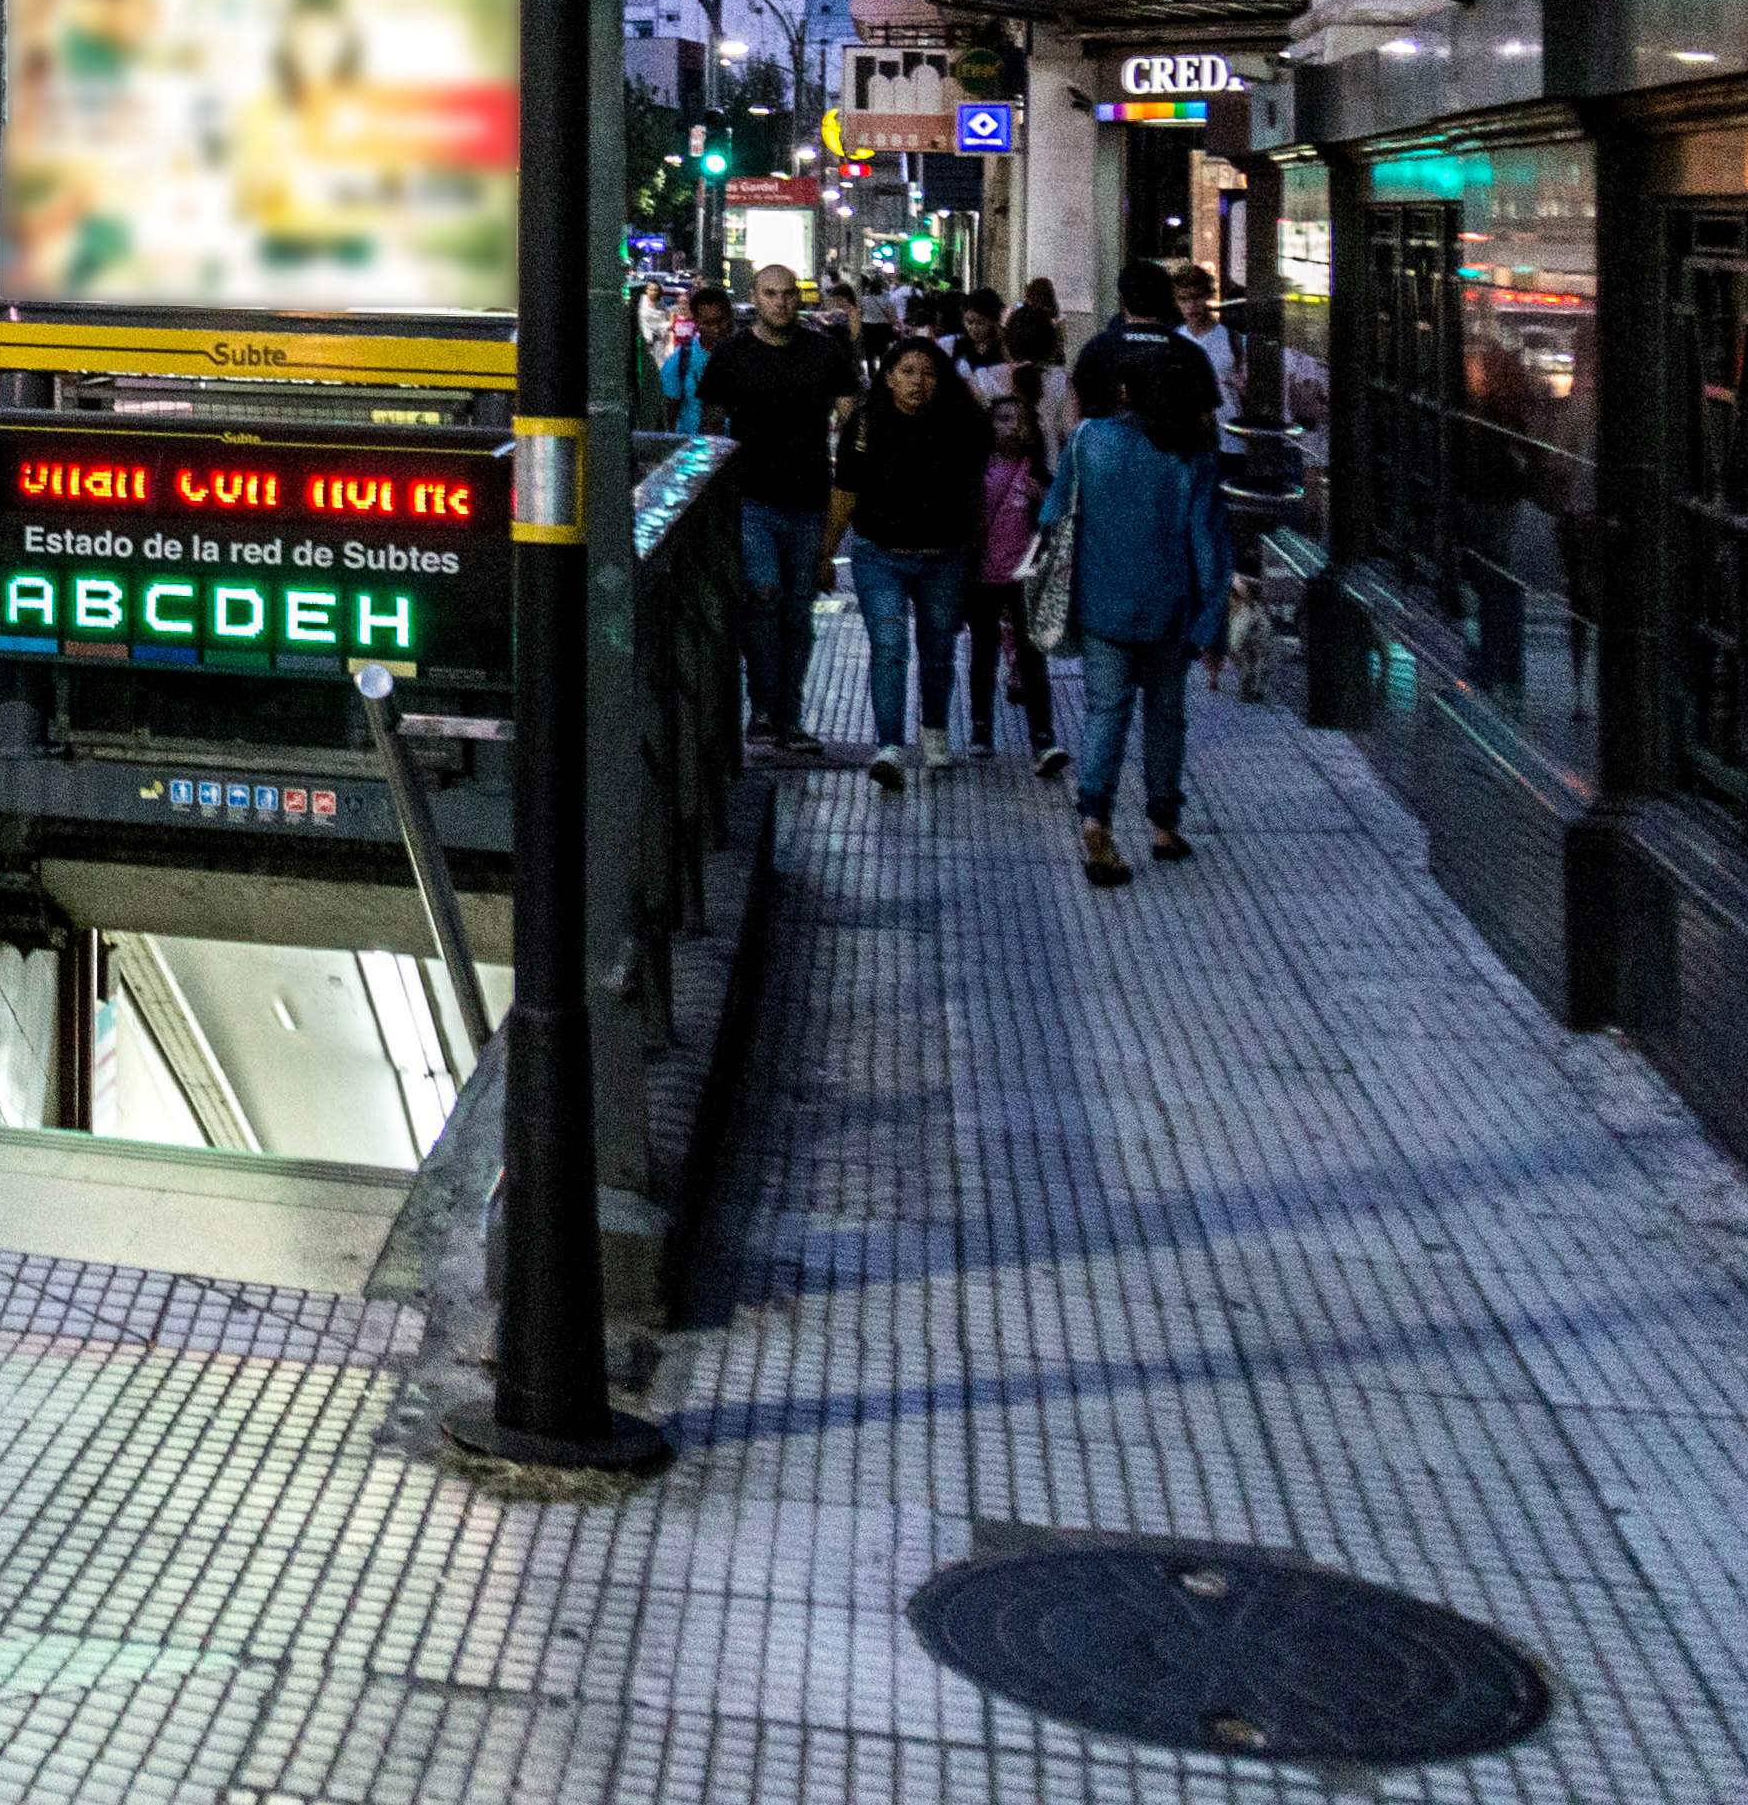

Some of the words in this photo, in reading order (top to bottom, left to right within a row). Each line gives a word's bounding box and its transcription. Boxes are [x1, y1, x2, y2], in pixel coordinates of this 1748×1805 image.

[212, 341, 288, 366] Subte
[24, 526, 133, 557] Estado
[143, 532, 182, 560] de
[192, 535, 220, 562] la
[231, 538, 282, 565] red
[293, 540, 334, 567] de
[343, 541, 460, 574] Subtes
